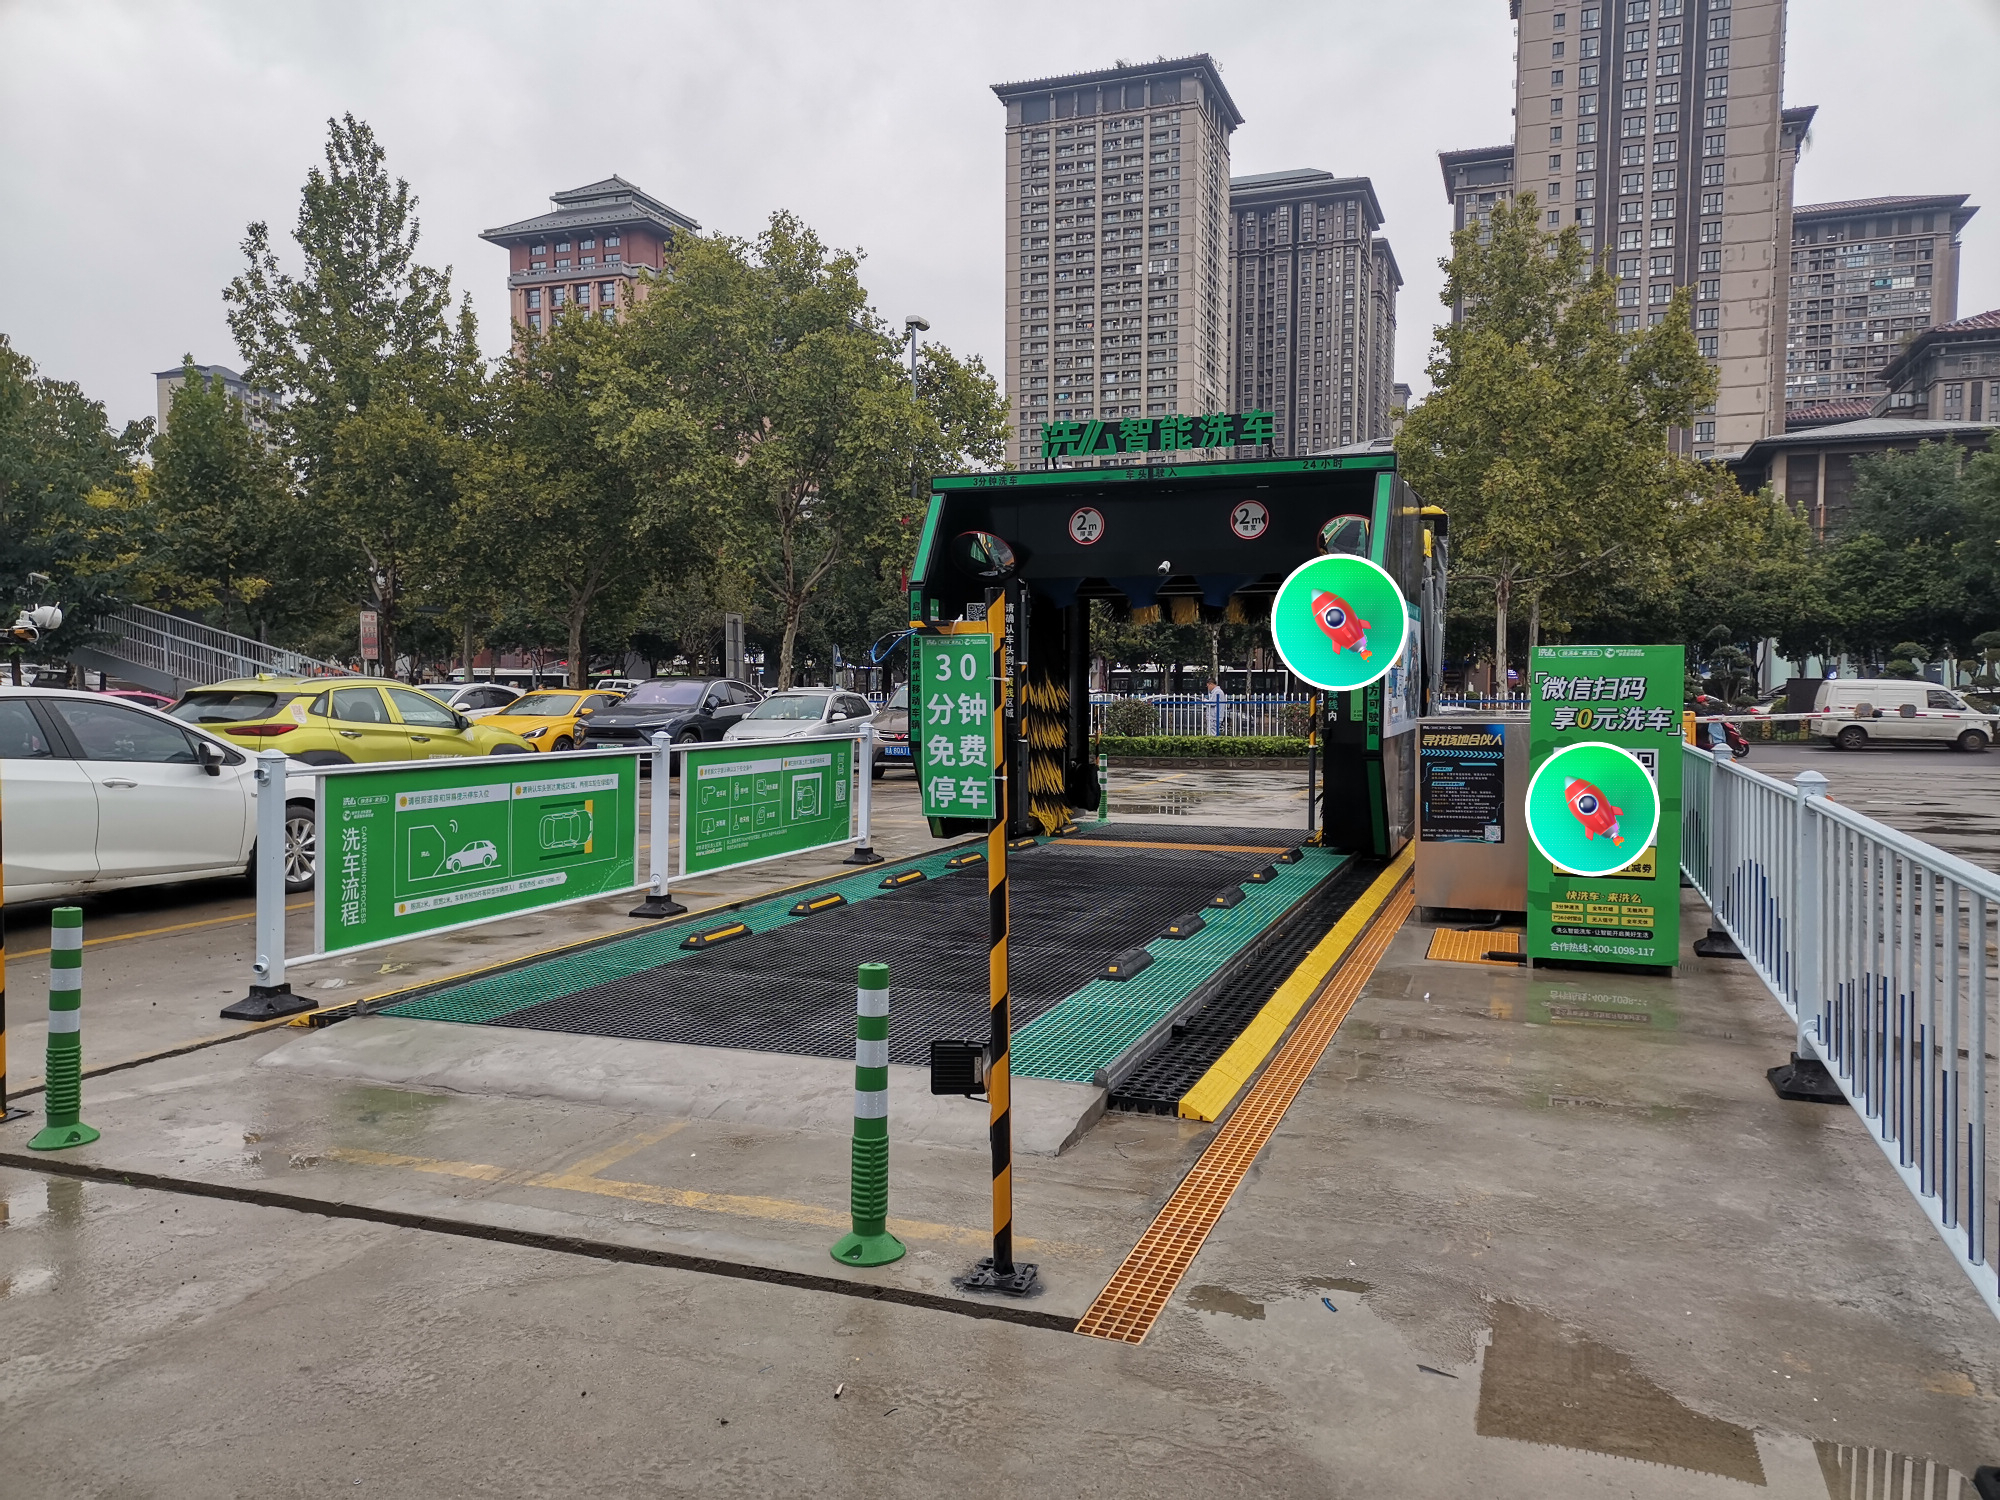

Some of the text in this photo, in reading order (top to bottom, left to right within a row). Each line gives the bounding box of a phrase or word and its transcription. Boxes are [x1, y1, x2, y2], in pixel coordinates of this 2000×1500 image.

[1041, 409, 1276, 458] 洗么智能洗车
[1125, 467, 1177, 479] 车头驶入
[1302, 458, 1343, 469] 24小时
[973, 476, 1018, 487] 3分钟洗车
[1076, 514, 1098, 531] 2m
[1239, 508, 1262, 525] 2m
[935, 653, 977, 681] 30
[926, 692, 987, 725] 分钟
[927, 734, 988, 767] 免费
[1422, 733, 1503, 746] 寻找场地合伙人
[927, 776, 988, 809] 停车
[341, 827, 361, 927] 洗车流程
